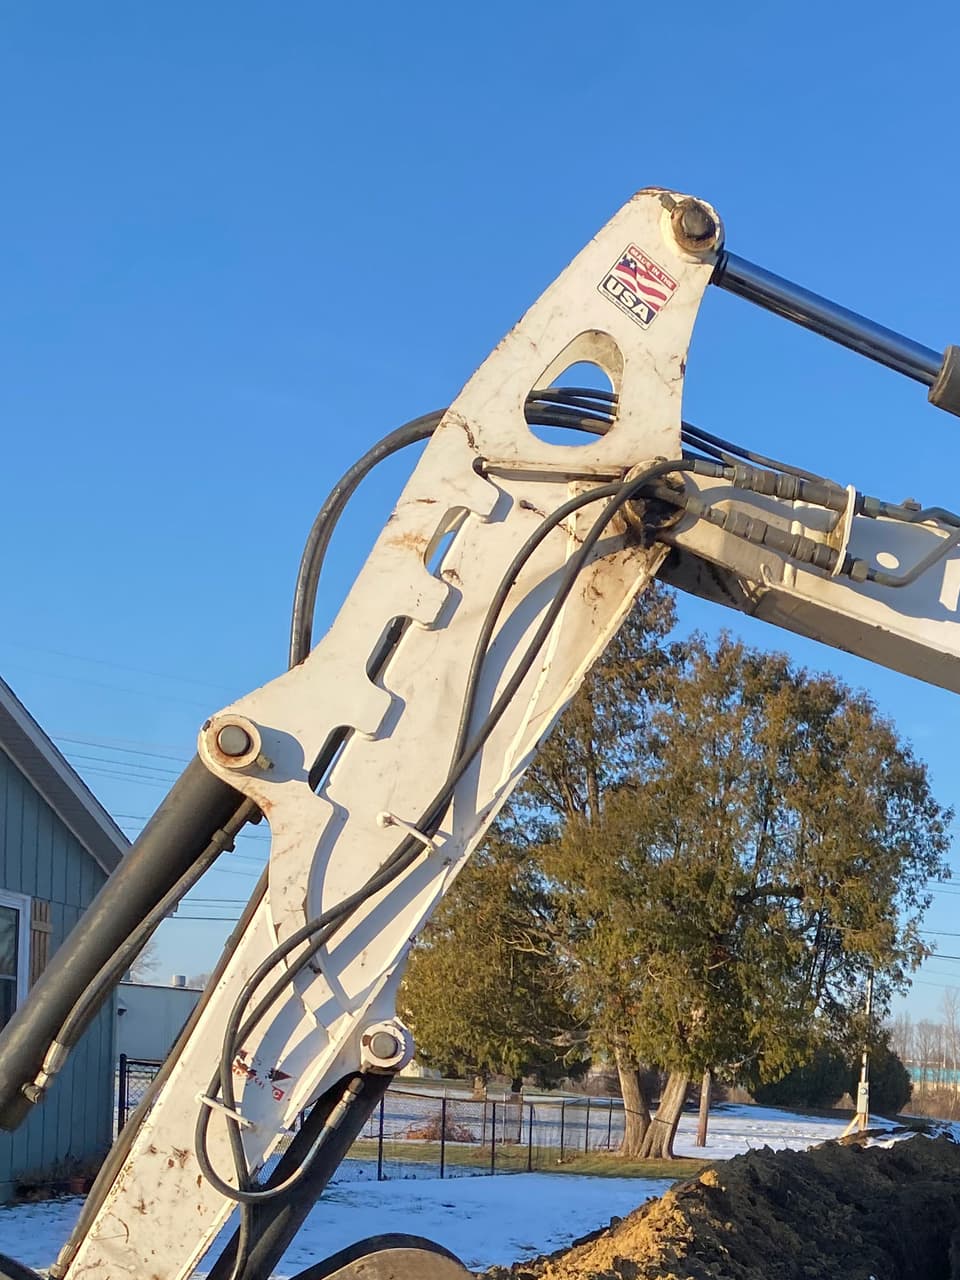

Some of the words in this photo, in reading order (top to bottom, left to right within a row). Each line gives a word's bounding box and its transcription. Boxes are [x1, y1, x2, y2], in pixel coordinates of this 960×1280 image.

[630, 248, 651, 269] MADE
[651, 265, 661, 277] IN
[660, 273, 675, 289] THE
[606, 277, 650, 322] USA
